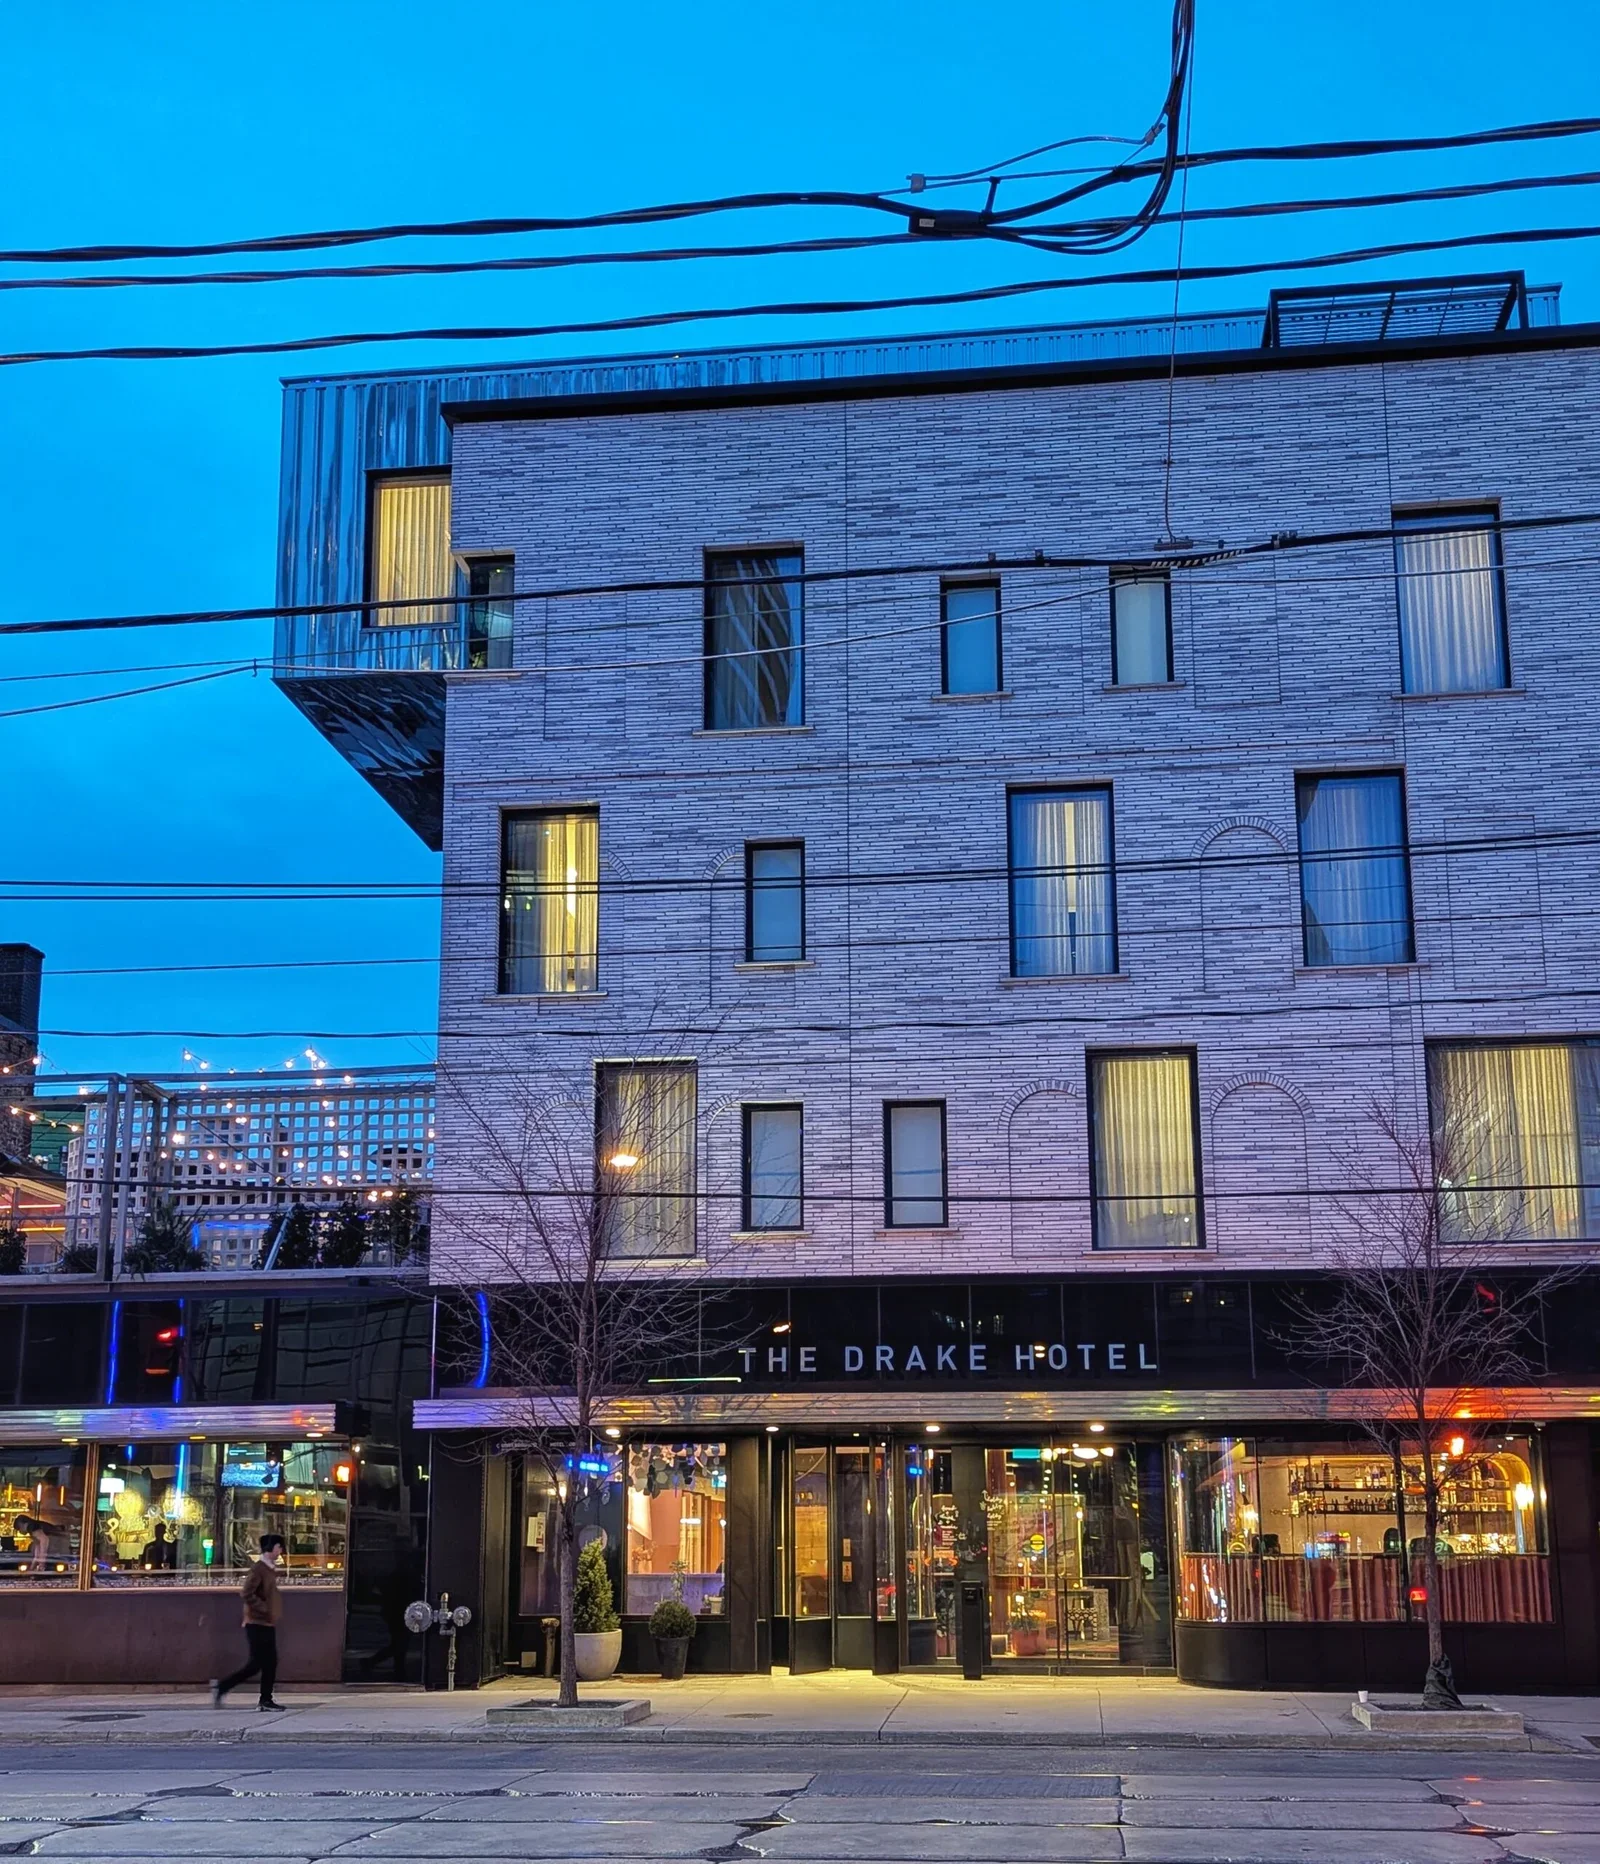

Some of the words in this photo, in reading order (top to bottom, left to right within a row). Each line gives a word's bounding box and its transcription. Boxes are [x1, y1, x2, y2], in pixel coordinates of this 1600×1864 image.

[738, 1347, 817, 1373] THE
[845, 1344, 987, 1372] DRAKE
[1016, 1343, 1157, 1371] HOTEL
